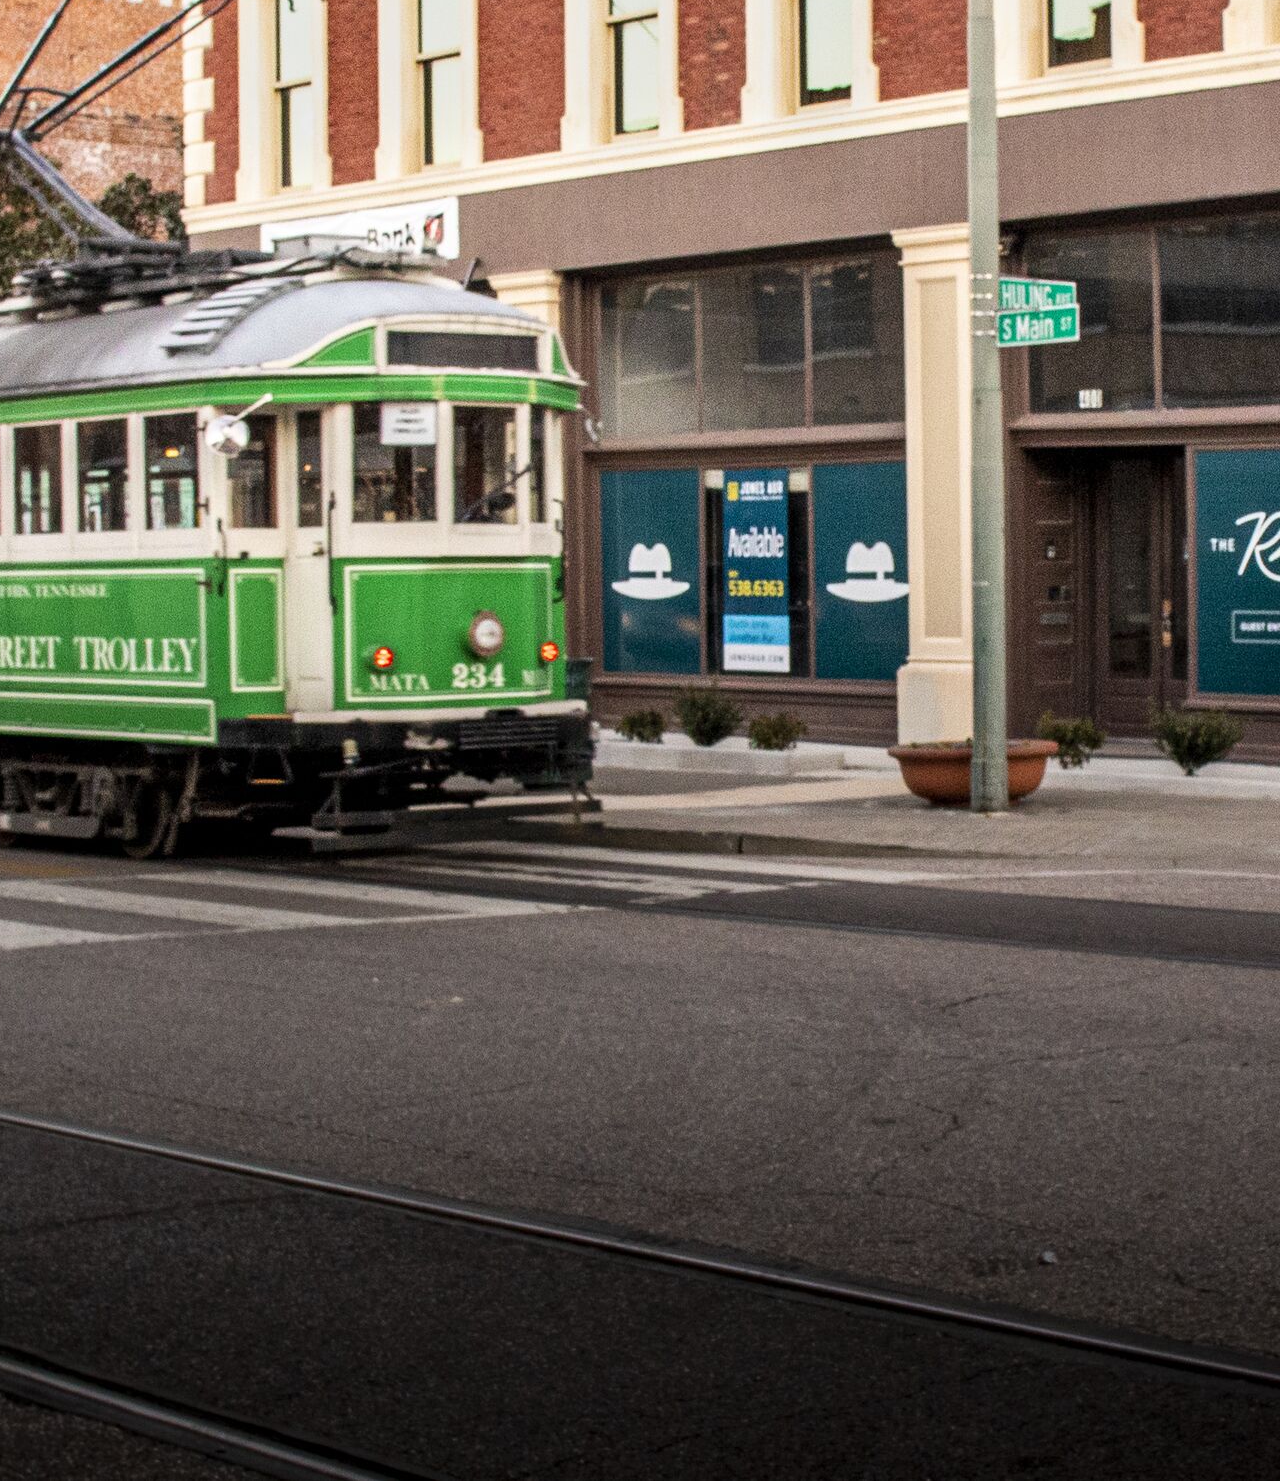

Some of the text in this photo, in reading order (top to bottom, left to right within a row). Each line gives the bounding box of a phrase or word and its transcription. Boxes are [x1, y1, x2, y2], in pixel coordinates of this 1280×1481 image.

[1002, 283, 1053, 309] HULING
[1002, 319, 1013, 341] S
[1016, 314, 1054, 340] Main
[727, 526, 785, 558] Available
[1210, 538, 1235, 552] THE
[73, 636, 197, 673] TROLLEY
[370, 674, 430, 691] MATA
[451, 662, 506, 688] 234
